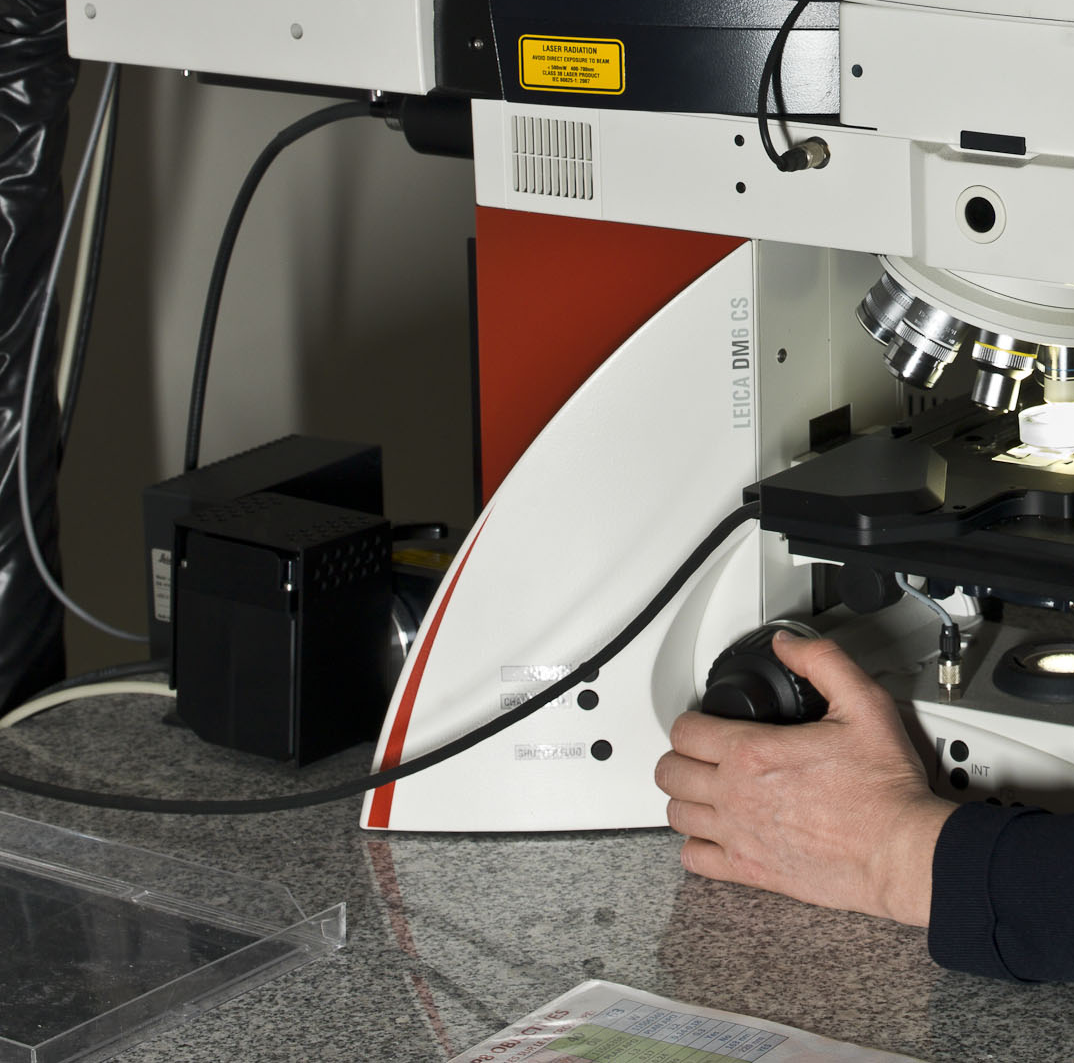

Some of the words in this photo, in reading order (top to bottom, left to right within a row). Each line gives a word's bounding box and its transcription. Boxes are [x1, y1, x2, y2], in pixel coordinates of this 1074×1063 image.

[542, 44, 562, 52] LASER
[564, 46, 597, 54] RADIATION
[731, 297, 749, 321] CS
[732, 328, 749, 369] DM6
[732, 376, 751, 428] LEICA
[971, 763, 990, 777] INT
[567, 1032, 585, 1043] 40
[704, 1030, 719, 1039] Yes
[719, 1034, 732, 1042] No
[603, 1046, 625, 1059] PLAN
[644, 1024, 663, 1035] PLAN
[757, 1043, 772, 1052] YES
